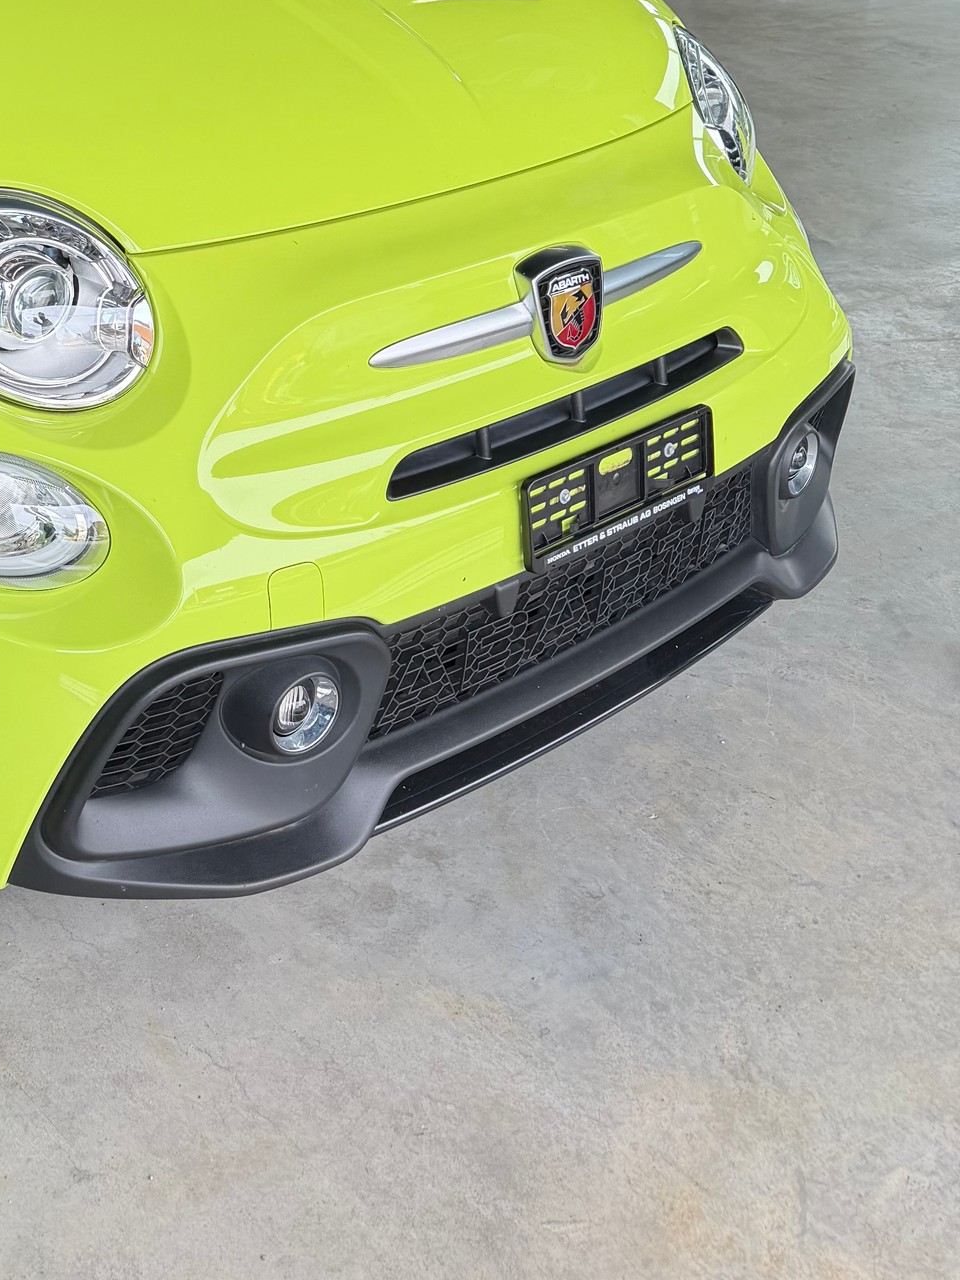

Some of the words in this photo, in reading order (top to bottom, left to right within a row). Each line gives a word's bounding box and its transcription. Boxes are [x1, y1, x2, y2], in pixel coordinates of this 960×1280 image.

[551, 273, 590, 293] ABARTH
[547, 549, 571, 565] HONDA
[572, 534, 599, 553] ETTER
[599, 531, 607, 540] &
[606, 515, 639, 537] STRAUB
[639, 509, 652, 521] AG
